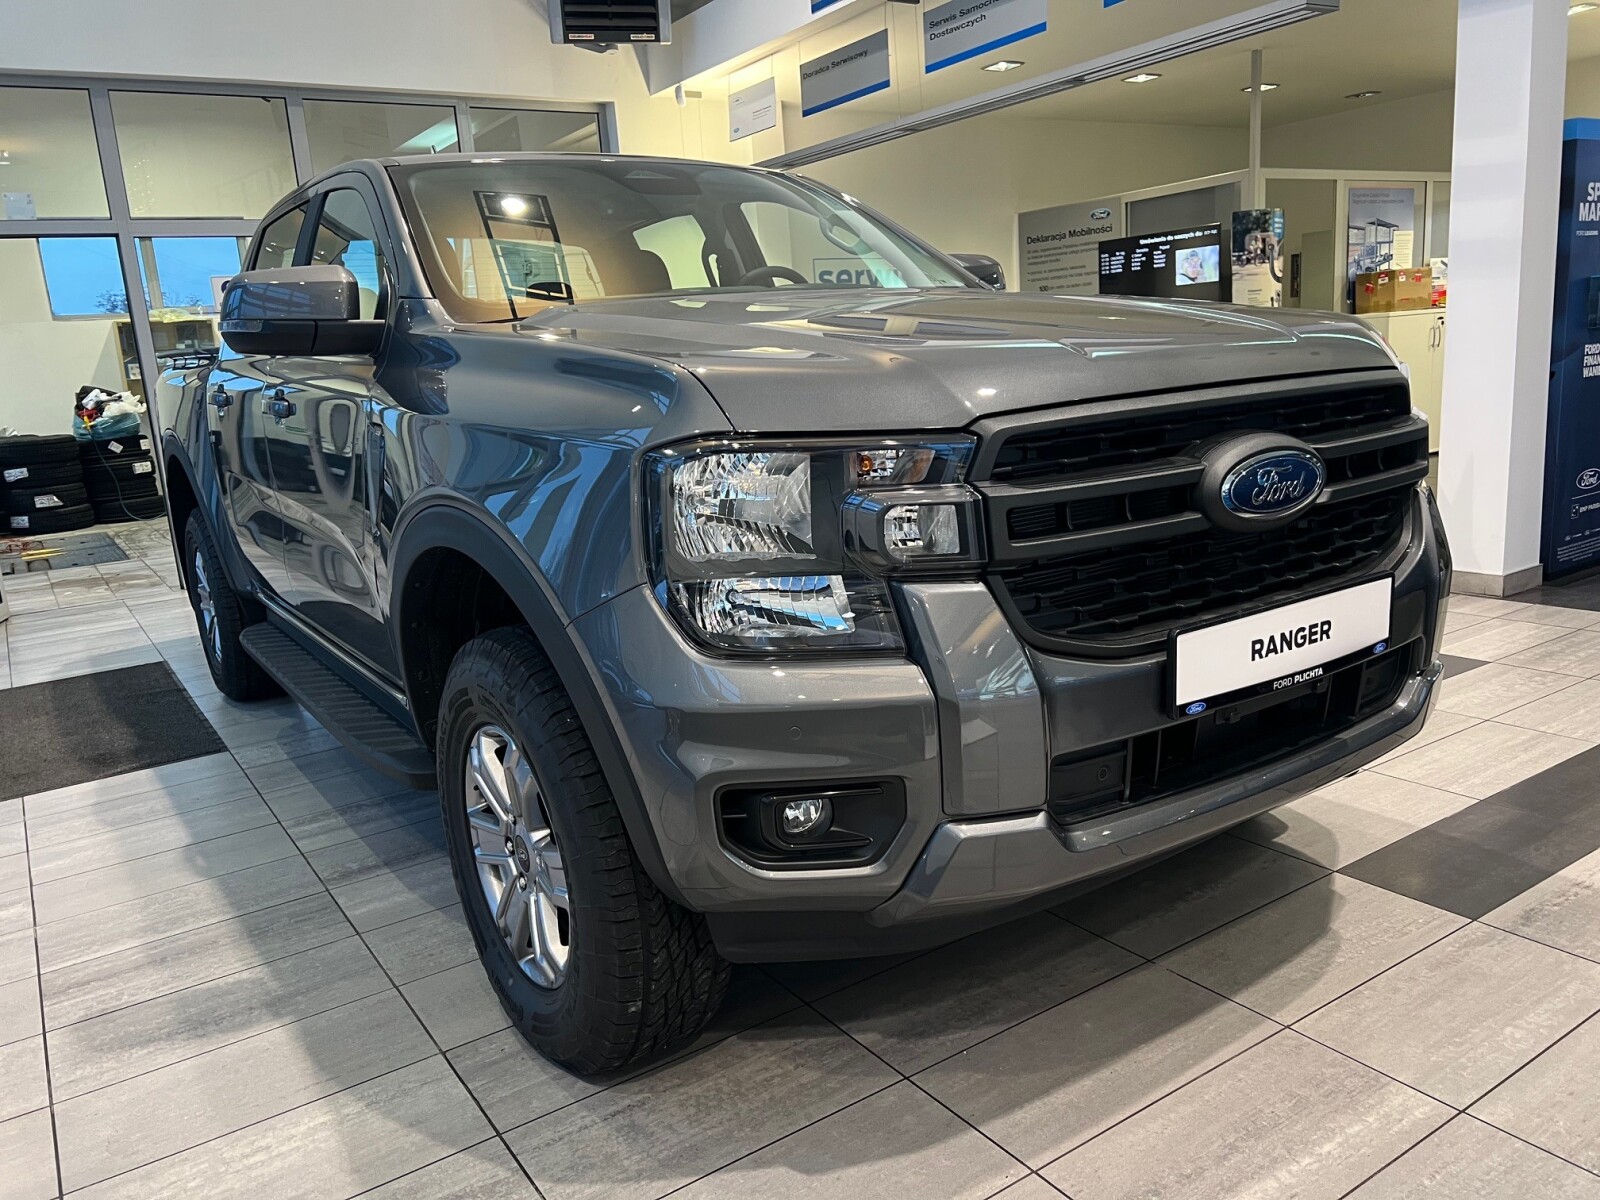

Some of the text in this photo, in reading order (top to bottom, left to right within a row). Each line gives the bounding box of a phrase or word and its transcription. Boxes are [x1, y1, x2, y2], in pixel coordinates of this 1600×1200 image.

[929, 13, 957, 29] Serwis
[929, 13, 986, 41] Dostawczych
[802, 49, 869, 80] Doradca Serwisowy
[1026, 224, 1113, 245] Deklaracja Mobilności
[1252, 464, 1306, 506] Ford
[1581, 471, 1599, 487] Ford
[1251, 619, 1332, 662] RANGER
[1273, 667, 1324, 690] FORD PLICHTA
